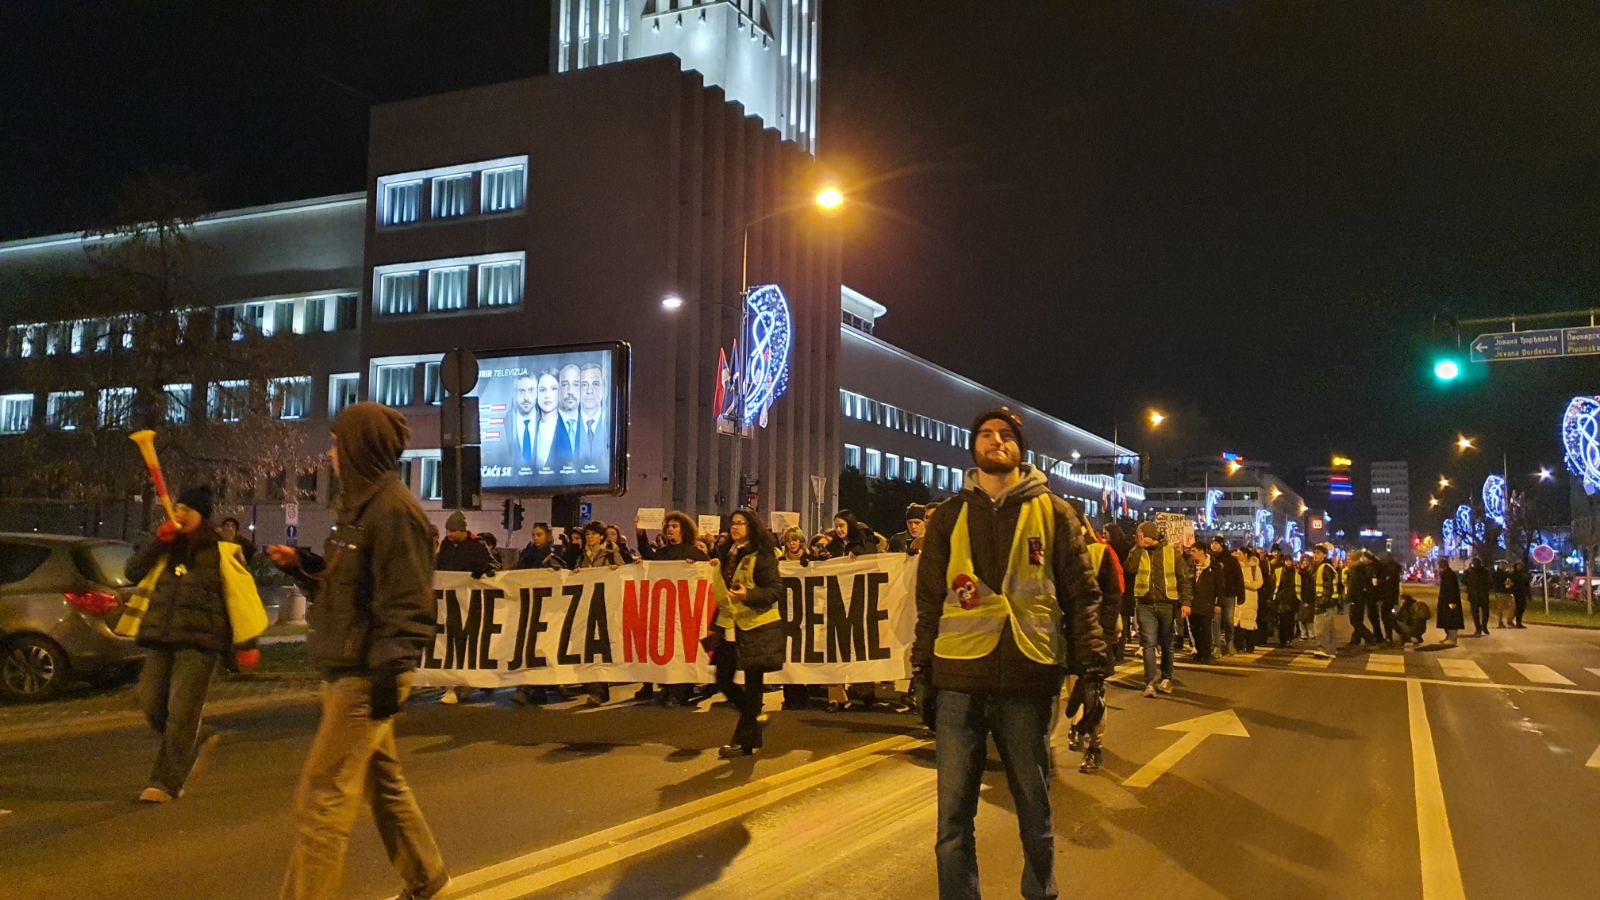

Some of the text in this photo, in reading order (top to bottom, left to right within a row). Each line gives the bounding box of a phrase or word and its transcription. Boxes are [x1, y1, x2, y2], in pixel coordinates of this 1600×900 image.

[494, 367, 528, 378] TELEVIZIJA
[423, 588, 504, 669] EME
[508, 587, 552, 670] JE
[557, 583, 613, 665] ZA
[777, 572, 891, 664] REME
